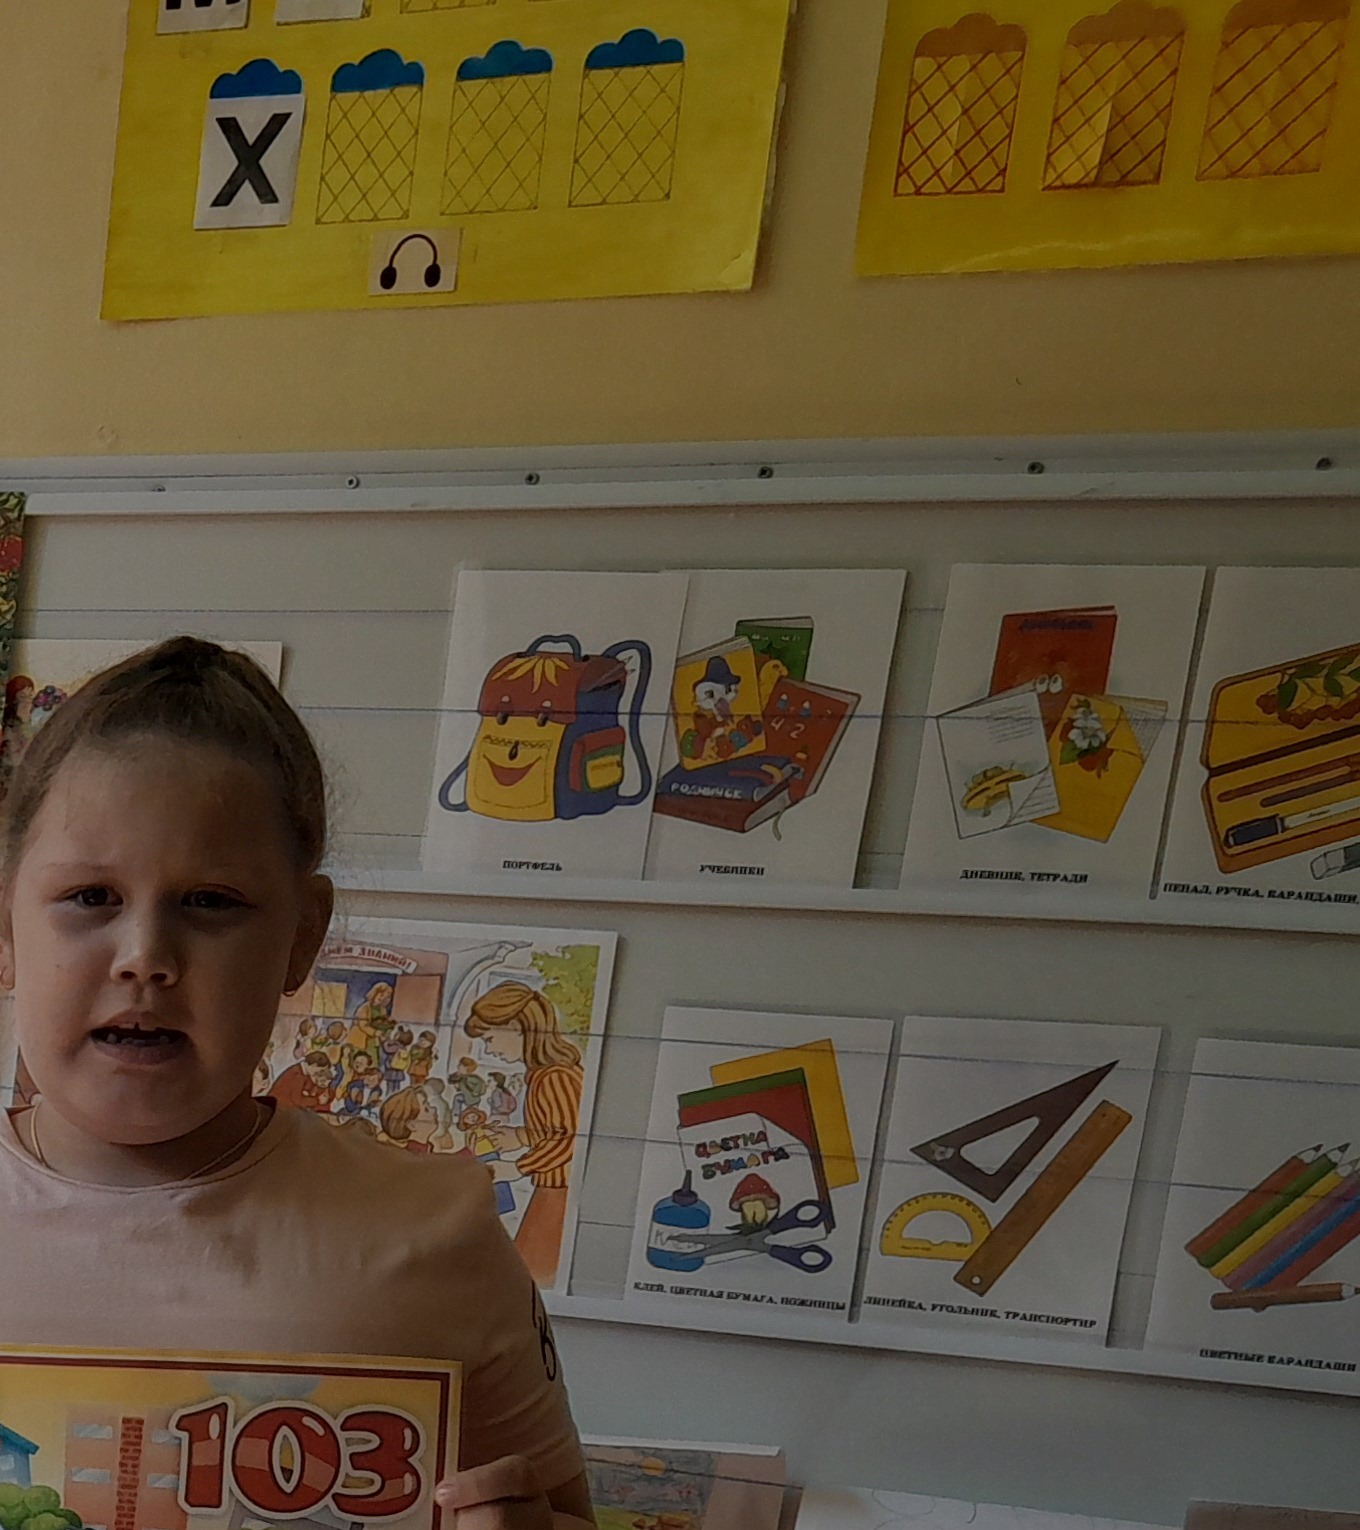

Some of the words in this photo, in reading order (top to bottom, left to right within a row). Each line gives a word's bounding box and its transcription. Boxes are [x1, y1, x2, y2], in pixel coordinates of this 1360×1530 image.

[502, 859, 562, 871] ПОРТФЕЛЬ
[1029, 872, 1088, 883] ТЕТРАДИ
[701, 1147, 790, 1180] БУМАГА
[670, 1285, 724, 1299] ЦВЕТНАЯ
[1267, 1355, 1357, 1372] КАРАНДАШИ
[172, 1399, 423, 1519] 103
